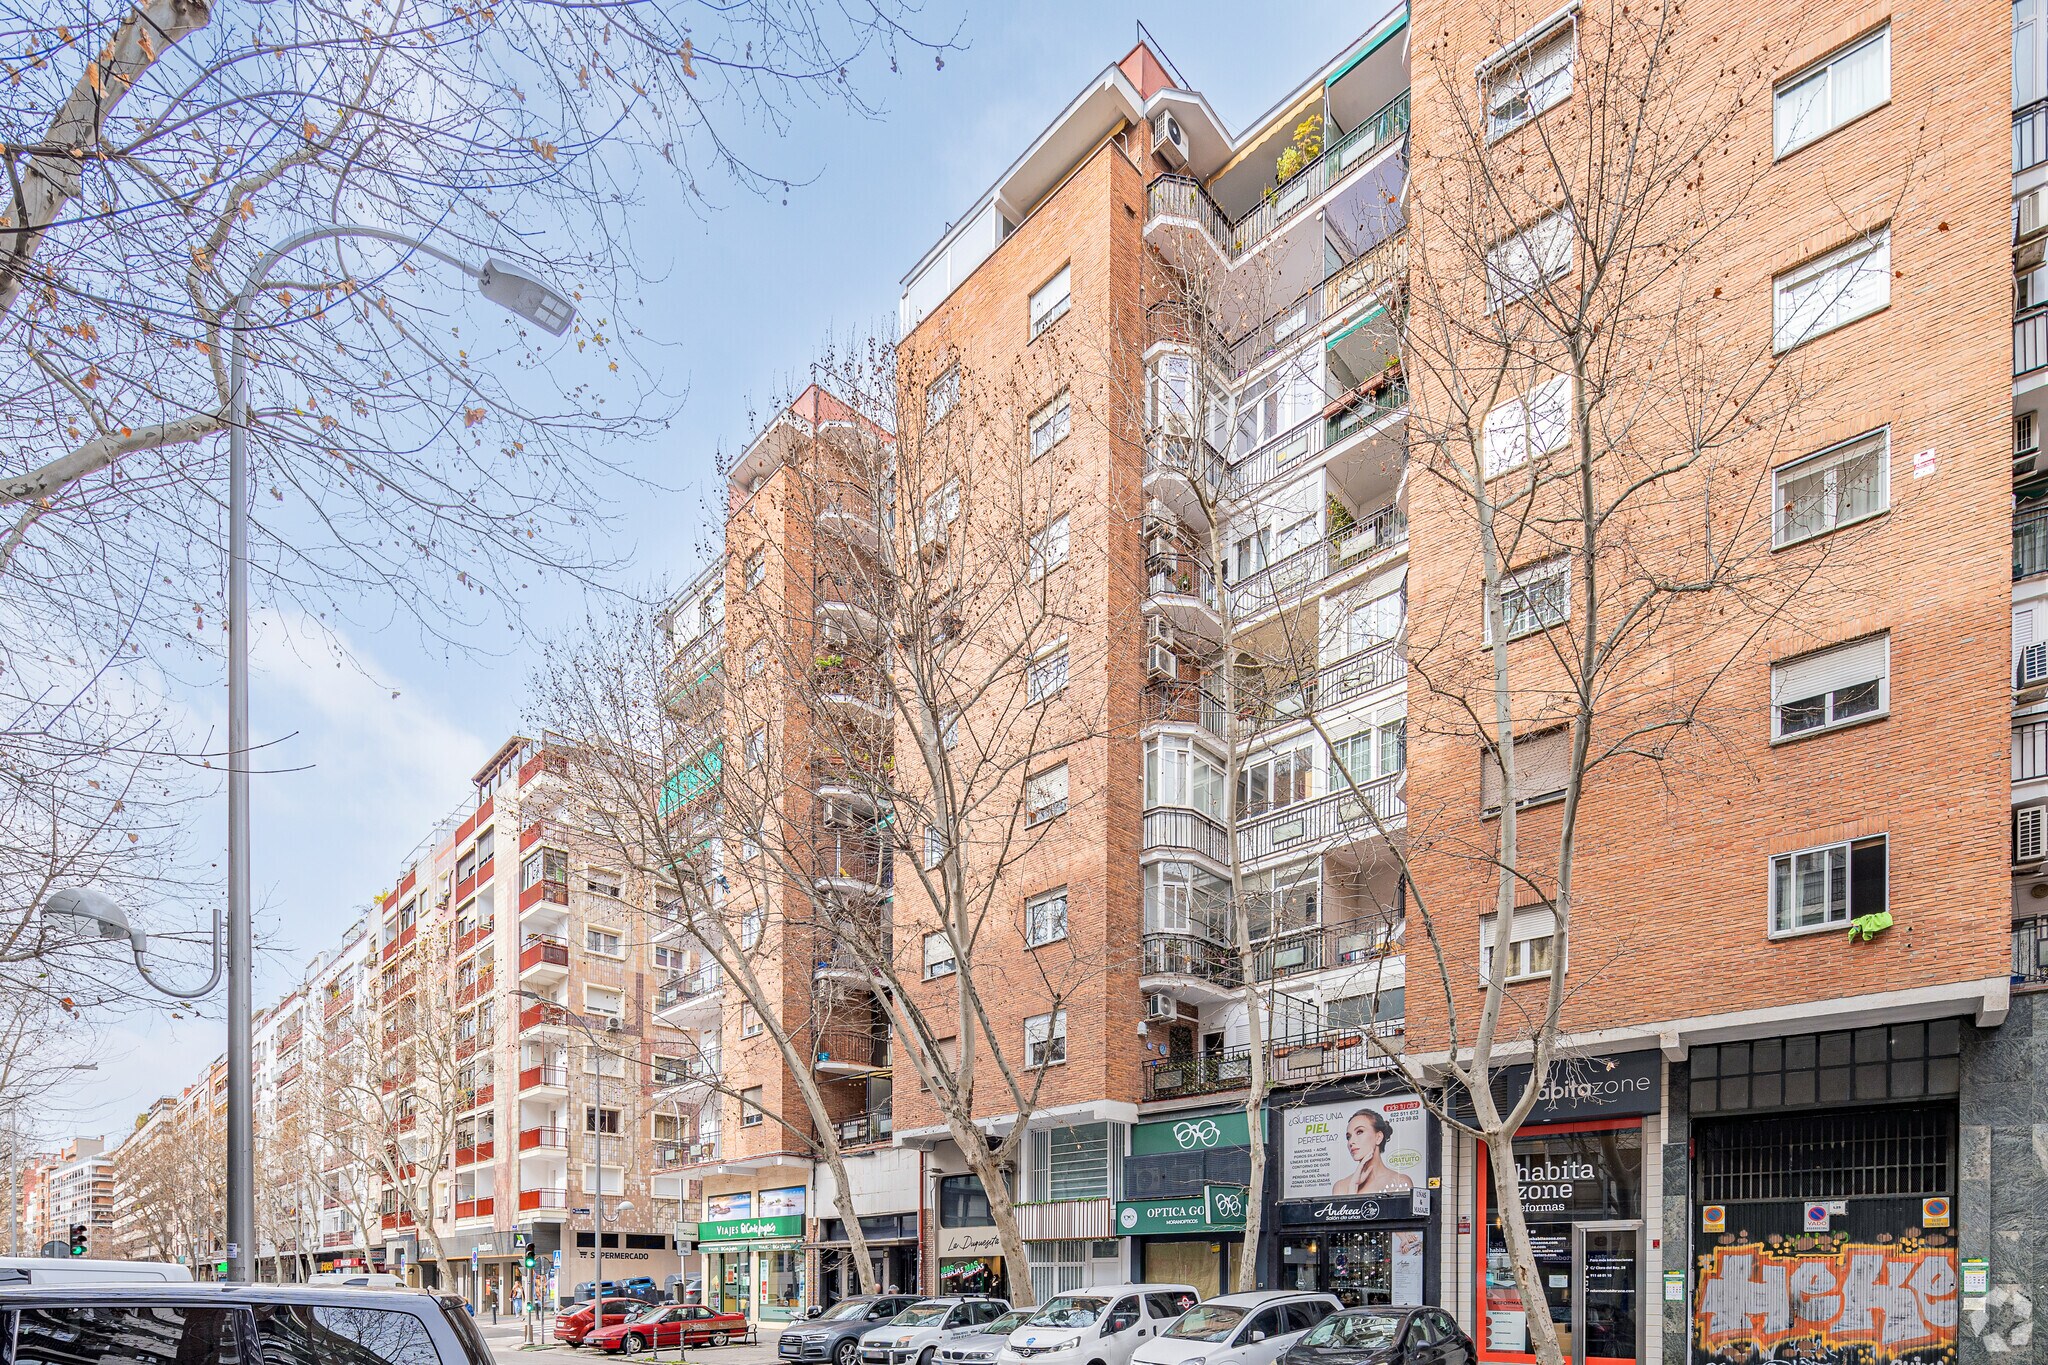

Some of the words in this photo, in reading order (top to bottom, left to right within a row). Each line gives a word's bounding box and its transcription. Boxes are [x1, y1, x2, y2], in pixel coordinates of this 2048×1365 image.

[1524, 1077, 1650, 1101] abitazone
[1288, 1113, 1324, 1127] ¿QUIERES
[1325, 1112, 1344, 1121] UNA
[1305, 1122, 1330, 1135] PIEL
[1297, 1133, 1339, 1145] PERFECTA?
[1389, 1155, 1420, 1164] GRATUITO
[1515, 1160, 1595, 1182] habita
[1518, 1183, 1573, 1200] zone
[1147, 1206, 1187, 1218] OPTICA
[1314, 1202, 1361, 1218] Andrea
[1521, 1203, 1565, 1213] eformas
[716, 1225, 739, 1237] VIAJES
[947, 1237, 960, 1251] La
[960, 1235, 1000, 1252] Duquesita
[590, 1251, 649, 1260] SPERMERCADO
